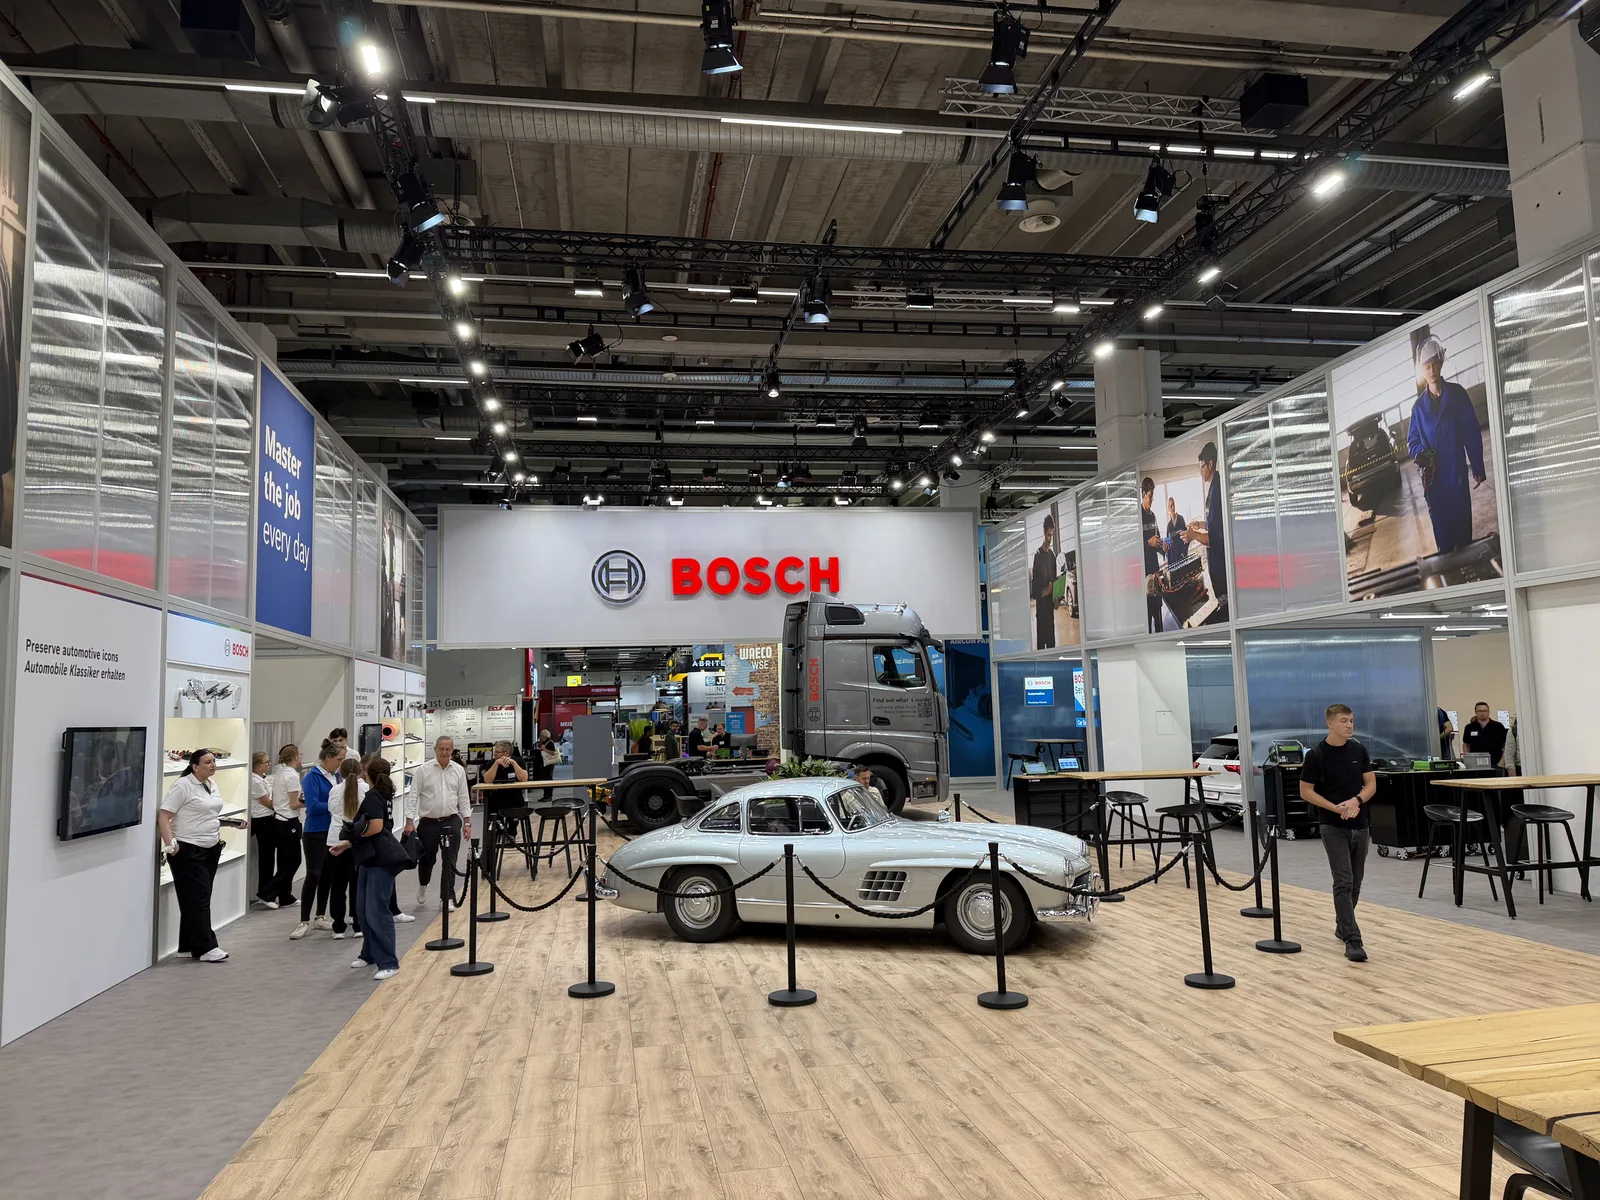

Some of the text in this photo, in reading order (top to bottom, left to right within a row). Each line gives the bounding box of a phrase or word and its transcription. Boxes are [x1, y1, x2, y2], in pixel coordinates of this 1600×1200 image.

[265, 424, 301, 479] Master
[264, 471, 301, 520] the job
[263, 521, 309, 571] every day
[671, 556, 840, 595] BOSCH
[25, 638, 119, 662] Preserve automotive icons
[232, 643, 249, 657] BOSCH
[739, 647, 772, 660] WAECO
[24, 659, 126, 681] Automobile Klassiker erhalten
[752, 660, 769, 670] WSE
[809, 657, 819, 701] BOSCH
[444, 697, 474, 708] GmbH
